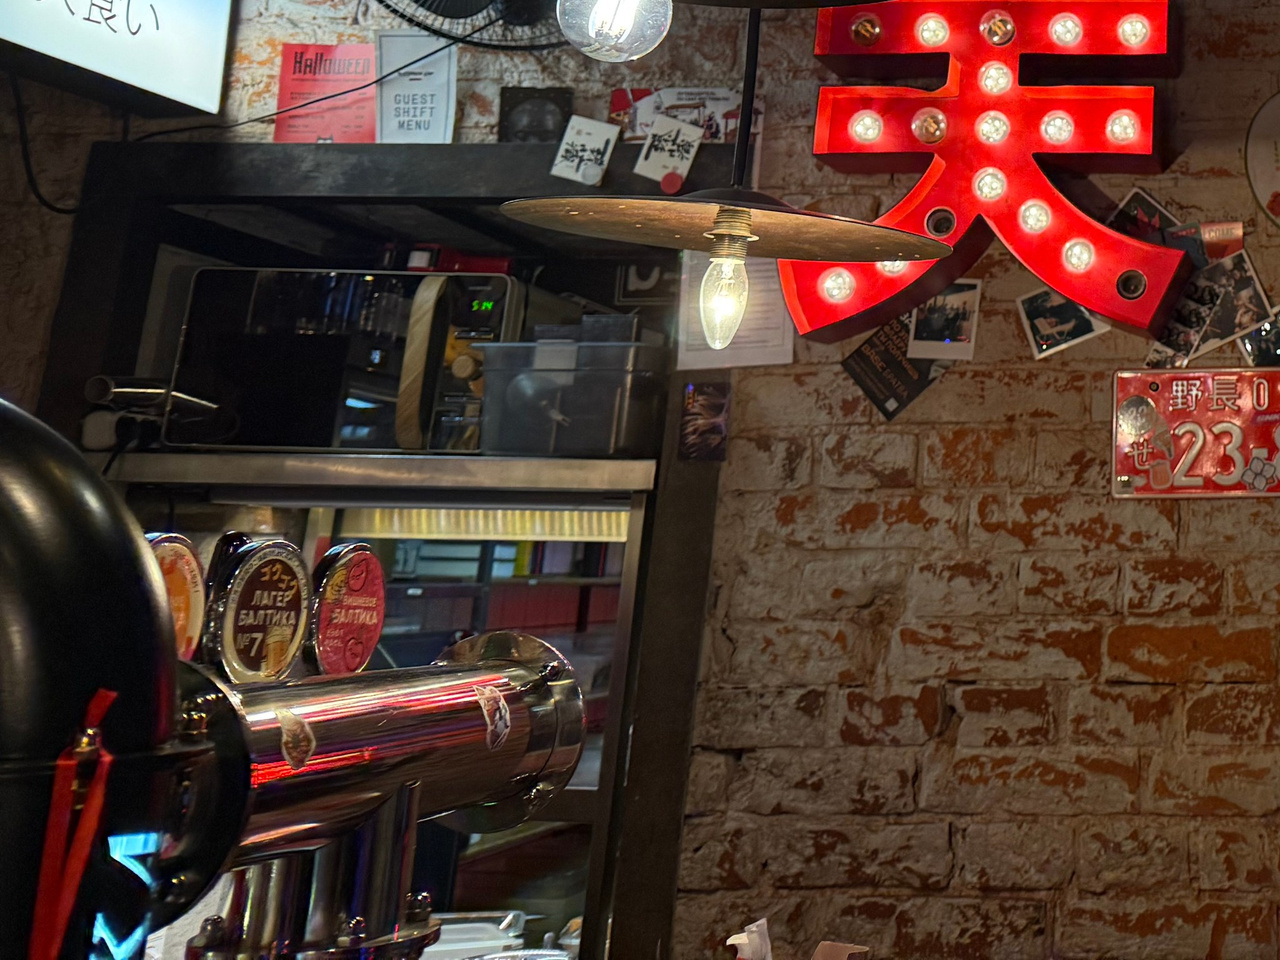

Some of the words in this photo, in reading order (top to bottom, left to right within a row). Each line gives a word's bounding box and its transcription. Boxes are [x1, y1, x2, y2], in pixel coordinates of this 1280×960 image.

[293, 51, 371, 76] Halloween
[394, 93, 437, 105] GUEST
[394, 106, 436, 118] SHIFT
[398, 120, 431, 130] MENU
[1169, 374, 1240, 412] 野長
[250, 589, 291, 607] ЛАГЕР
[237, 608, 297, 627] БАЛТИКА
[330, 606, 379, 626] БАЛТИКА
